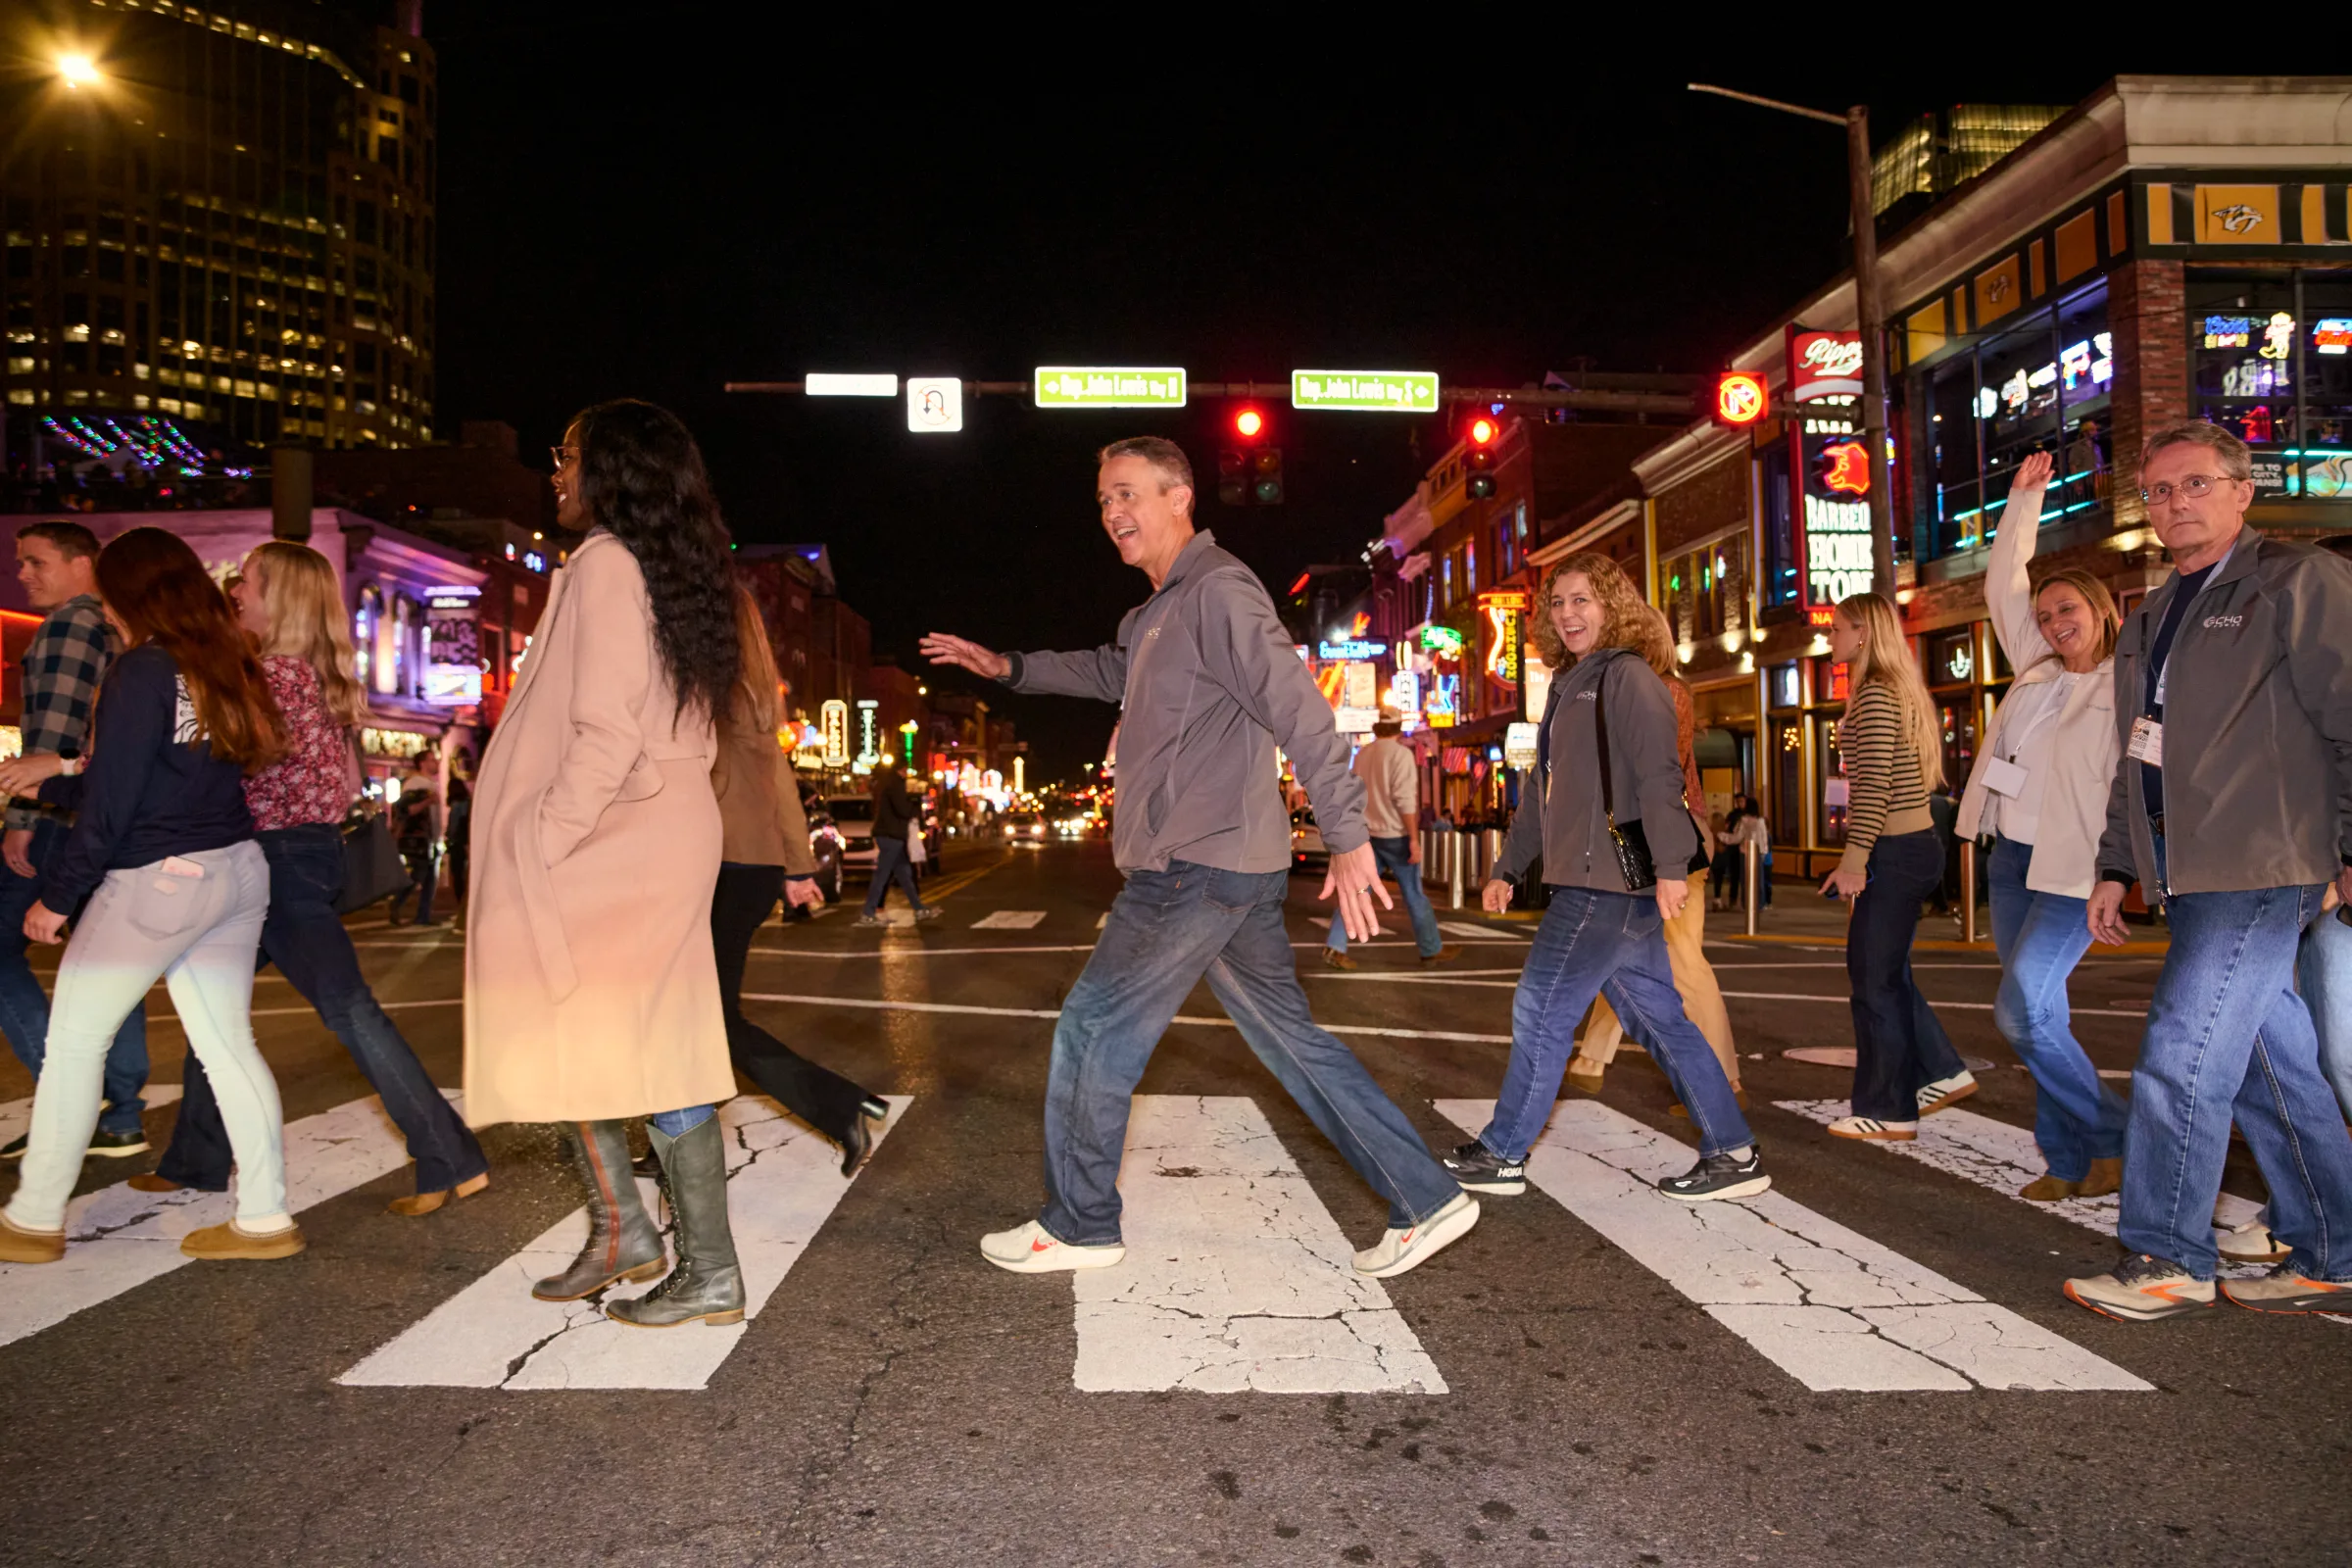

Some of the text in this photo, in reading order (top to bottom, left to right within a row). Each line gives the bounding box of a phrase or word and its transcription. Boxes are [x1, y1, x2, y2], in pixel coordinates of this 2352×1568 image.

[1085, 374, 1112, 396] John
[1113, 374, 1148, 396] Lewis
[1150, 380, 1166, 399] Way
[1323, 377, 1351, 399] John
[1351, 377, 1385, 400] Lewis
[1808, 533, 1874, 570] HONK
[1810, 570, 1874, 605] TON
[1812, 612, 1834, 624] NA
[1505, 609, 1518, 679] MUSHROOM
[1497, 1166, 1523, 1178] HOKA
